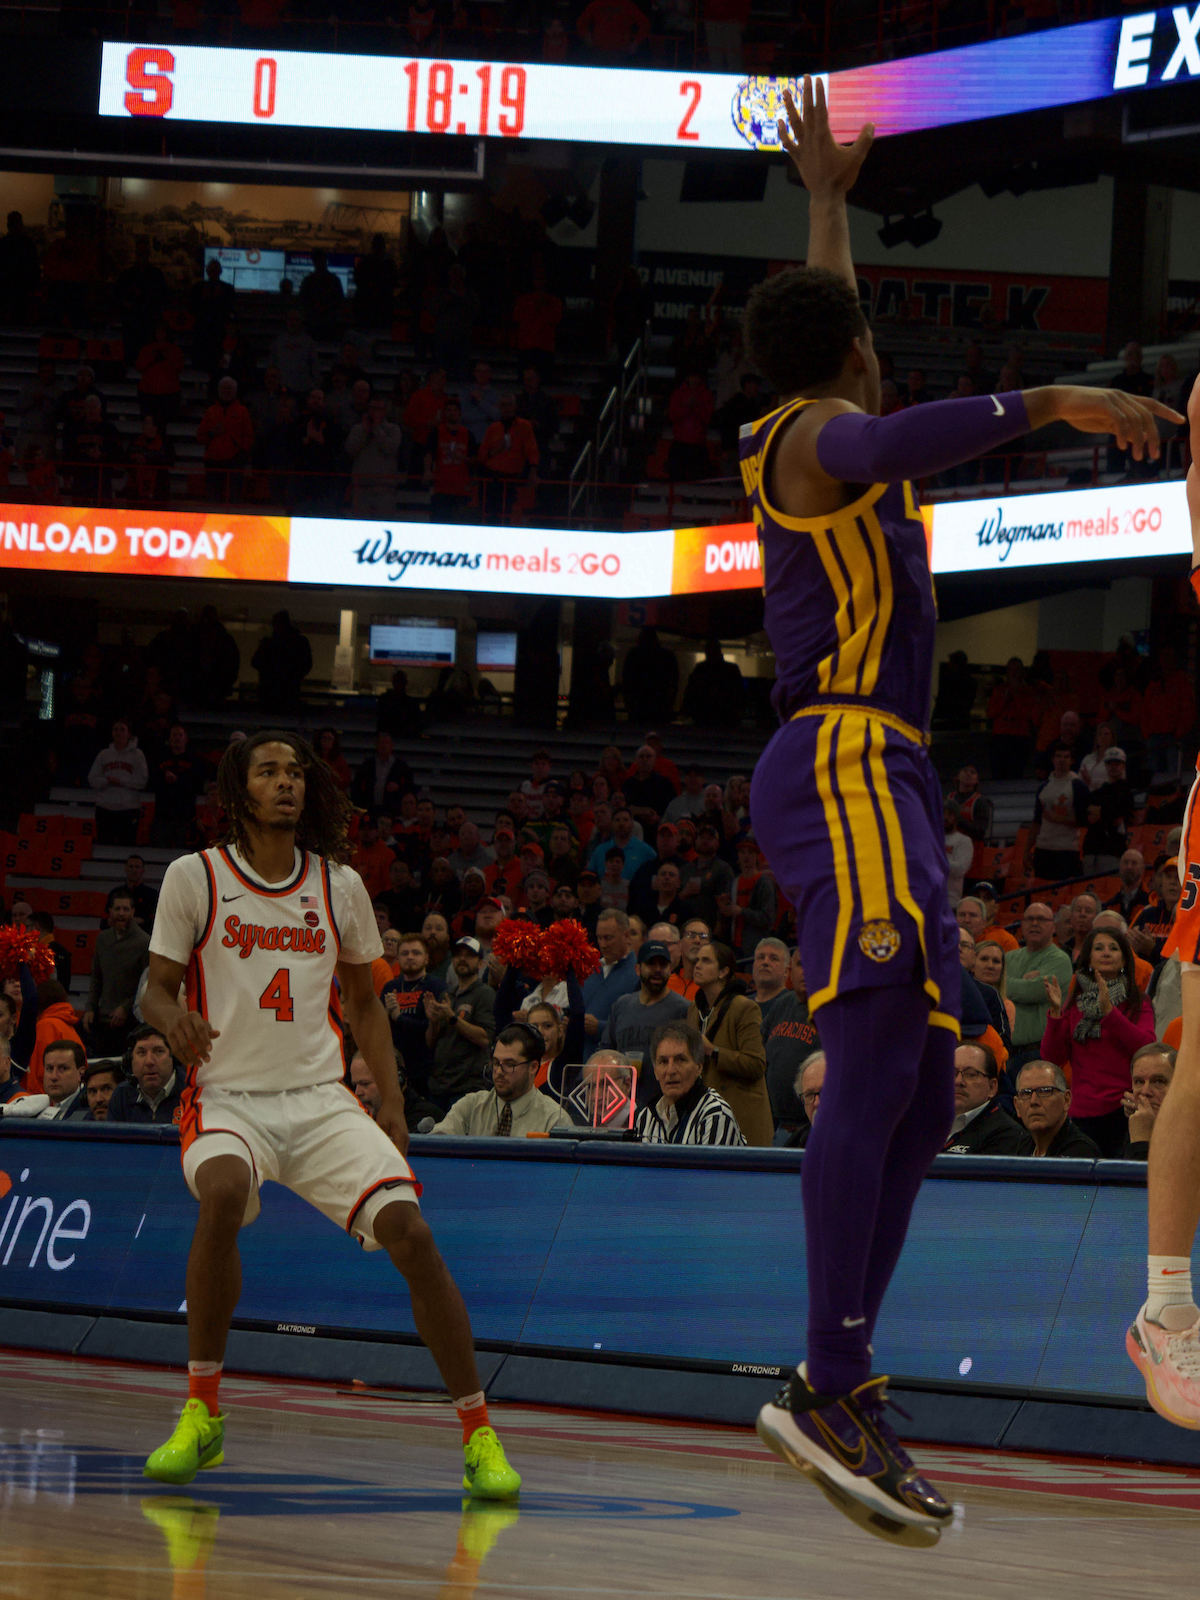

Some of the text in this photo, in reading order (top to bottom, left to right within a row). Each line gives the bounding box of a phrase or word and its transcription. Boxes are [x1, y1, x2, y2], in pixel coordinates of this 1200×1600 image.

[253, 58, 277, 118] 0
[404, 61, 527, 136] 18:19
[677, 81, 702, 140] 2
[0, 521, 233, 560] NLOAD TODAY
[352, 530, 621, 582] Wegmans meals 2GO
[976, 506, 1162, 562] Wegmans meals 2GO
[221, 914, 326, 959] Syracuse
[259, 968, 294, 1021] 4
[277, 1323, 316, 1335] DAKTRONICS
[732, 1364, 780, 1376] DAKTRONICS
